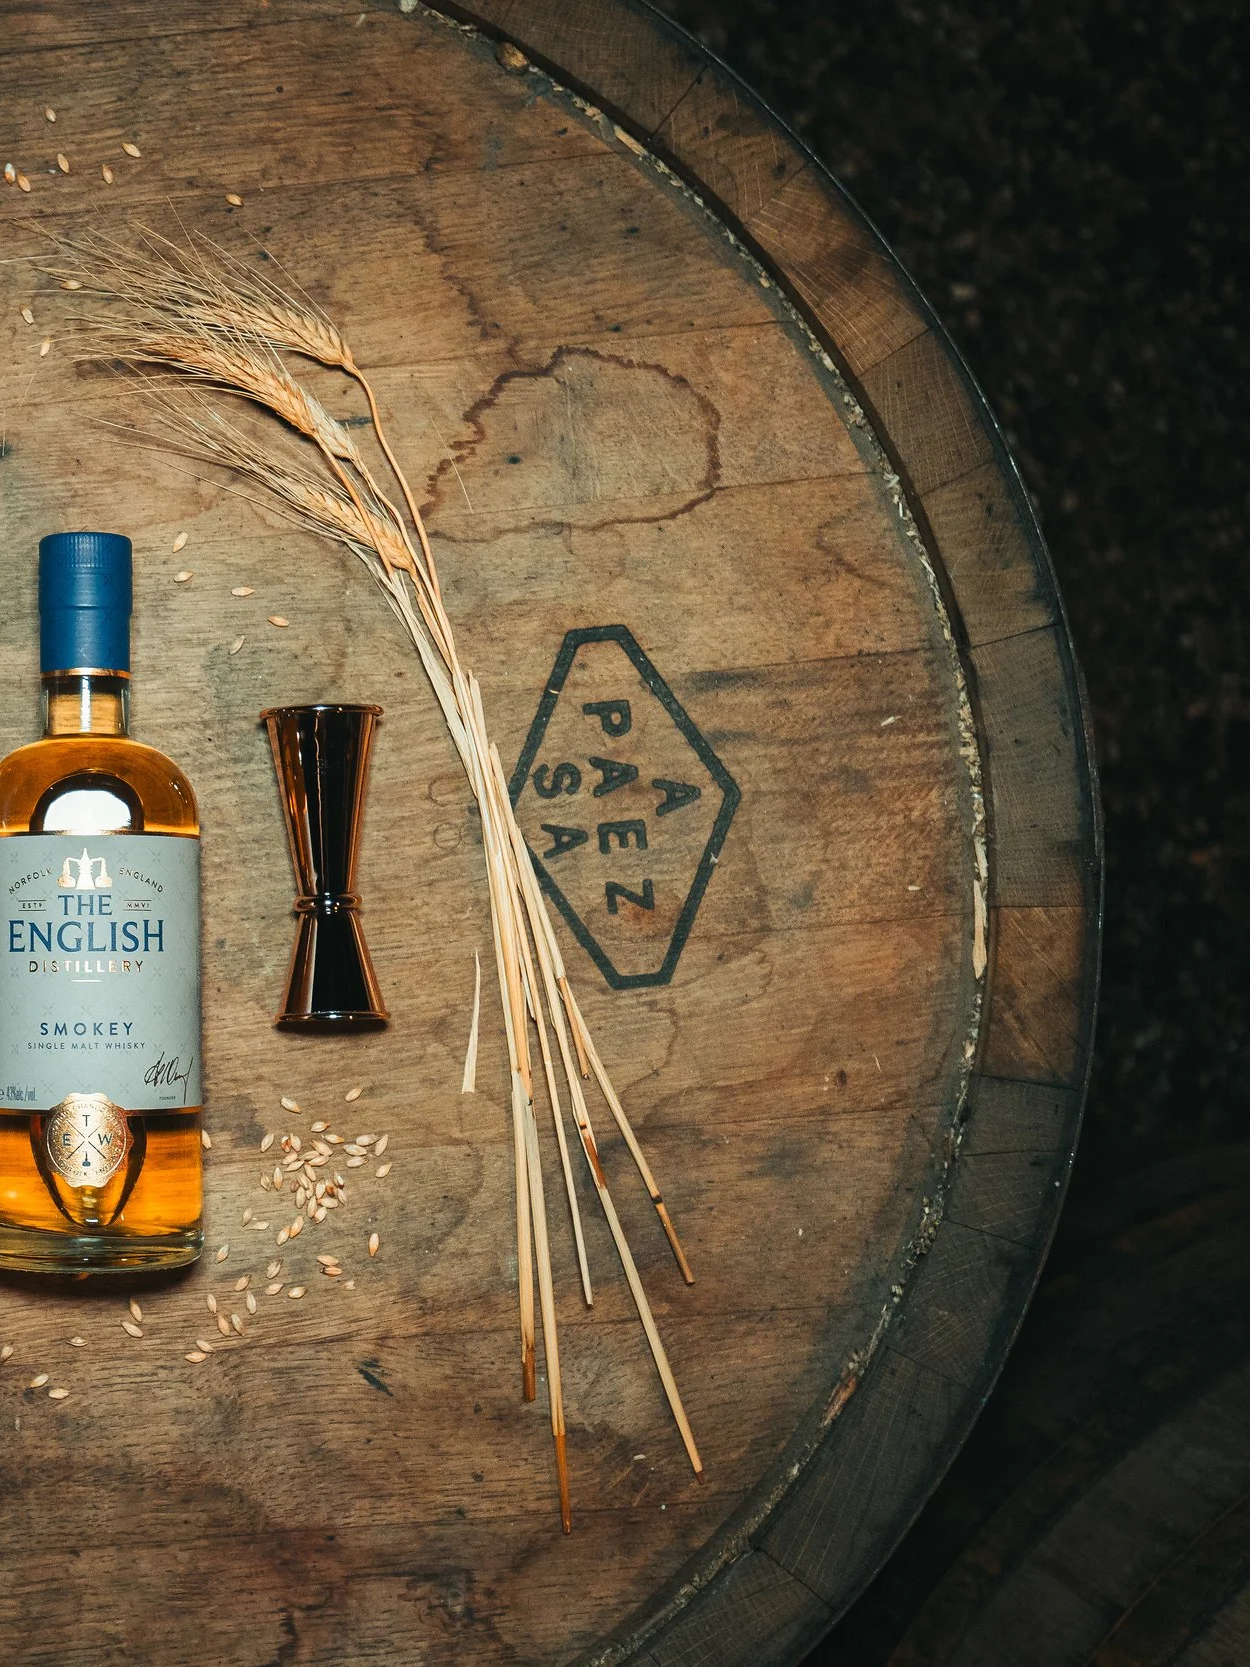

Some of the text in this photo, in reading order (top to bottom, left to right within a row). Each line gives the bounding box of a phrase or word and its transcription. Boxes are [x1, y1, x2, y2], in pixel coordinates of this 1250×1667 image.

[582, 699, 655, 915] PAEZ
[8, 867, 52, 894] NORFOLK
[119, 867, 164, 893] ENGLAND
[57, 894, 113, 916] THE
[8, 919, 165, 953] ENGLISH
[29, 960, 144, 973] DISTILLERY
[40, 1022, 134, 1036] SMOKEY
[27, 1042, 146, 1050] SINGLE MALT WHISKY
[82, 1114, 91, 1127] T
[62, 1133, 113, 1147] E W
